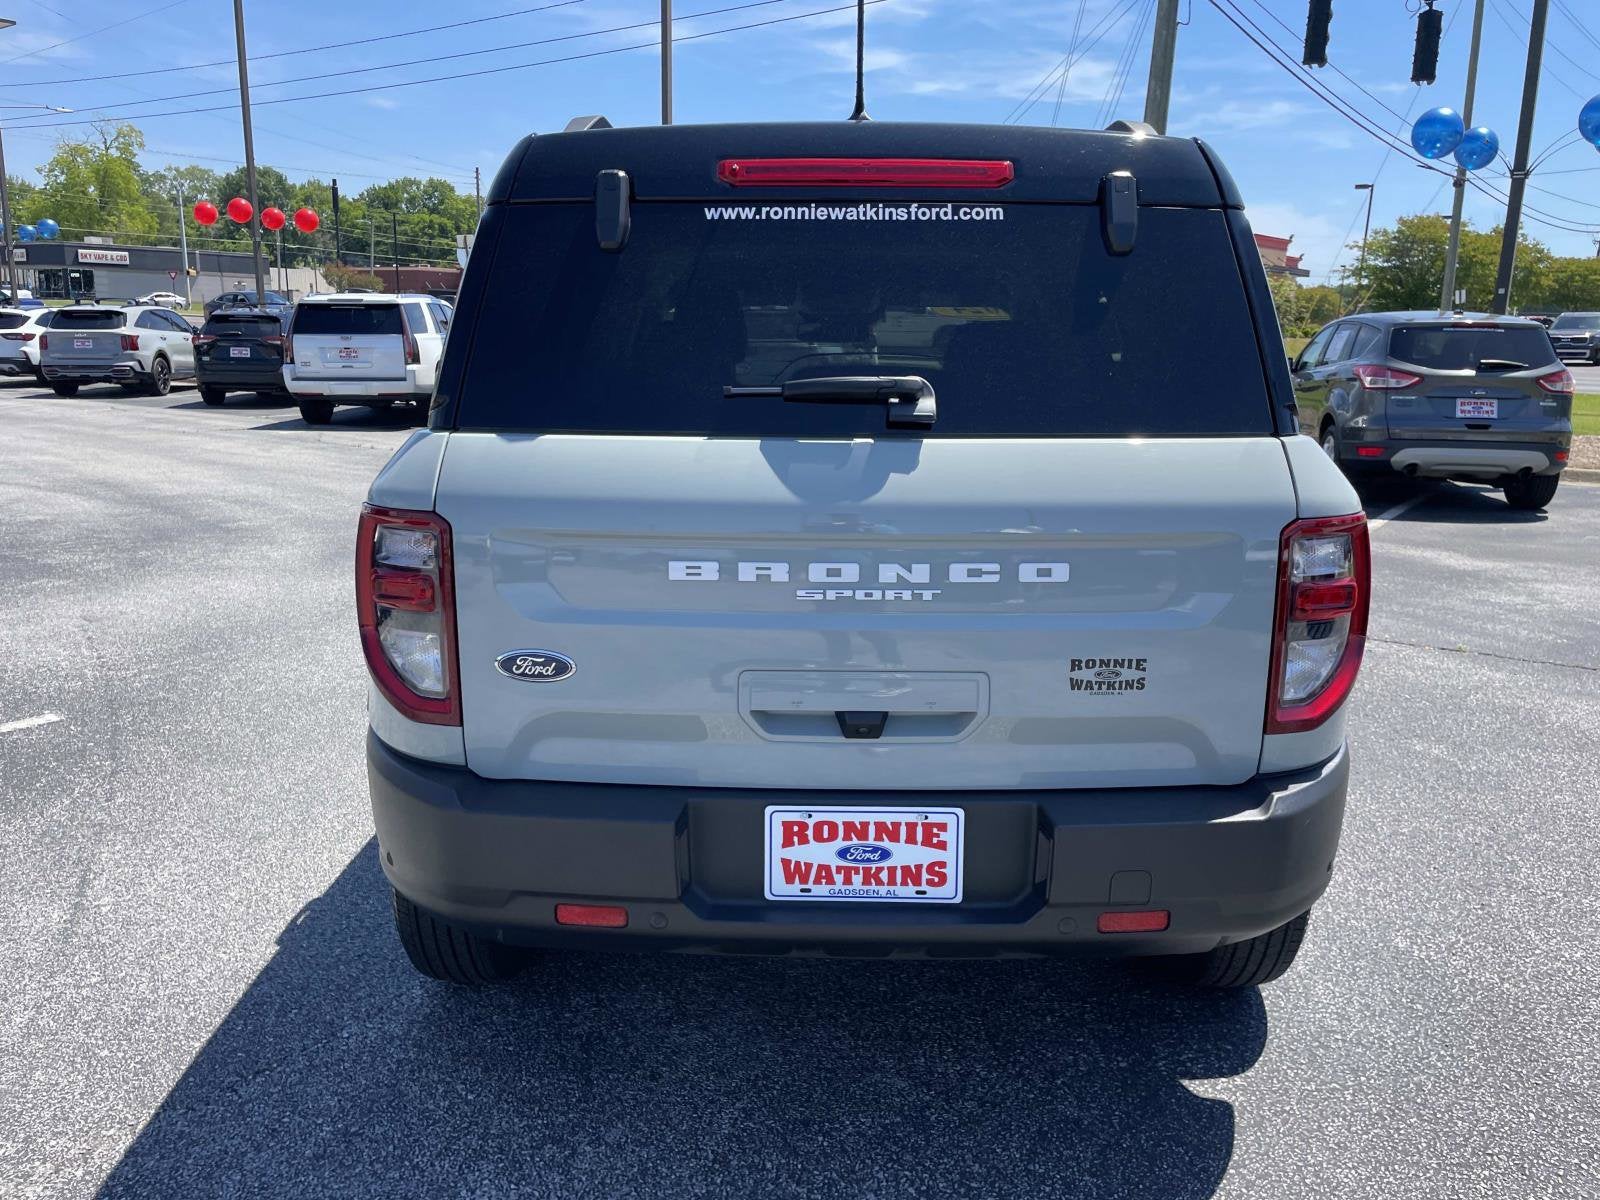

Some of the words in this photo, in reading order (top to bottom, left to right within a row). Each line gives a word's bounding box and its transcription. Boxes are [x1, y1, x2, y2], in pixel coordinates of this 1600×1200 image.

[704, 203, 1004, 221] www.ronniewatkinsford.com
[80, 252, 92, 260] SKY
[93, 253, 108, 261] VAPE
[668, 560, 1071, 584] BRONCO
[795, 589, 942, 602] SPORT
[512, 656, 556, 676] Ford
[1069, 658, 1148, 673] RONNIE
[1069, 676, 1147, 691] WATKINS
[781, 820, 948, 852] RONNIE
[846, 846, 881, 861] Ford
[780, 857, 948, 888] WATKINS
[828, 888, 883, 898] GADSDEN,
[885, 888, 899, 897] AL
